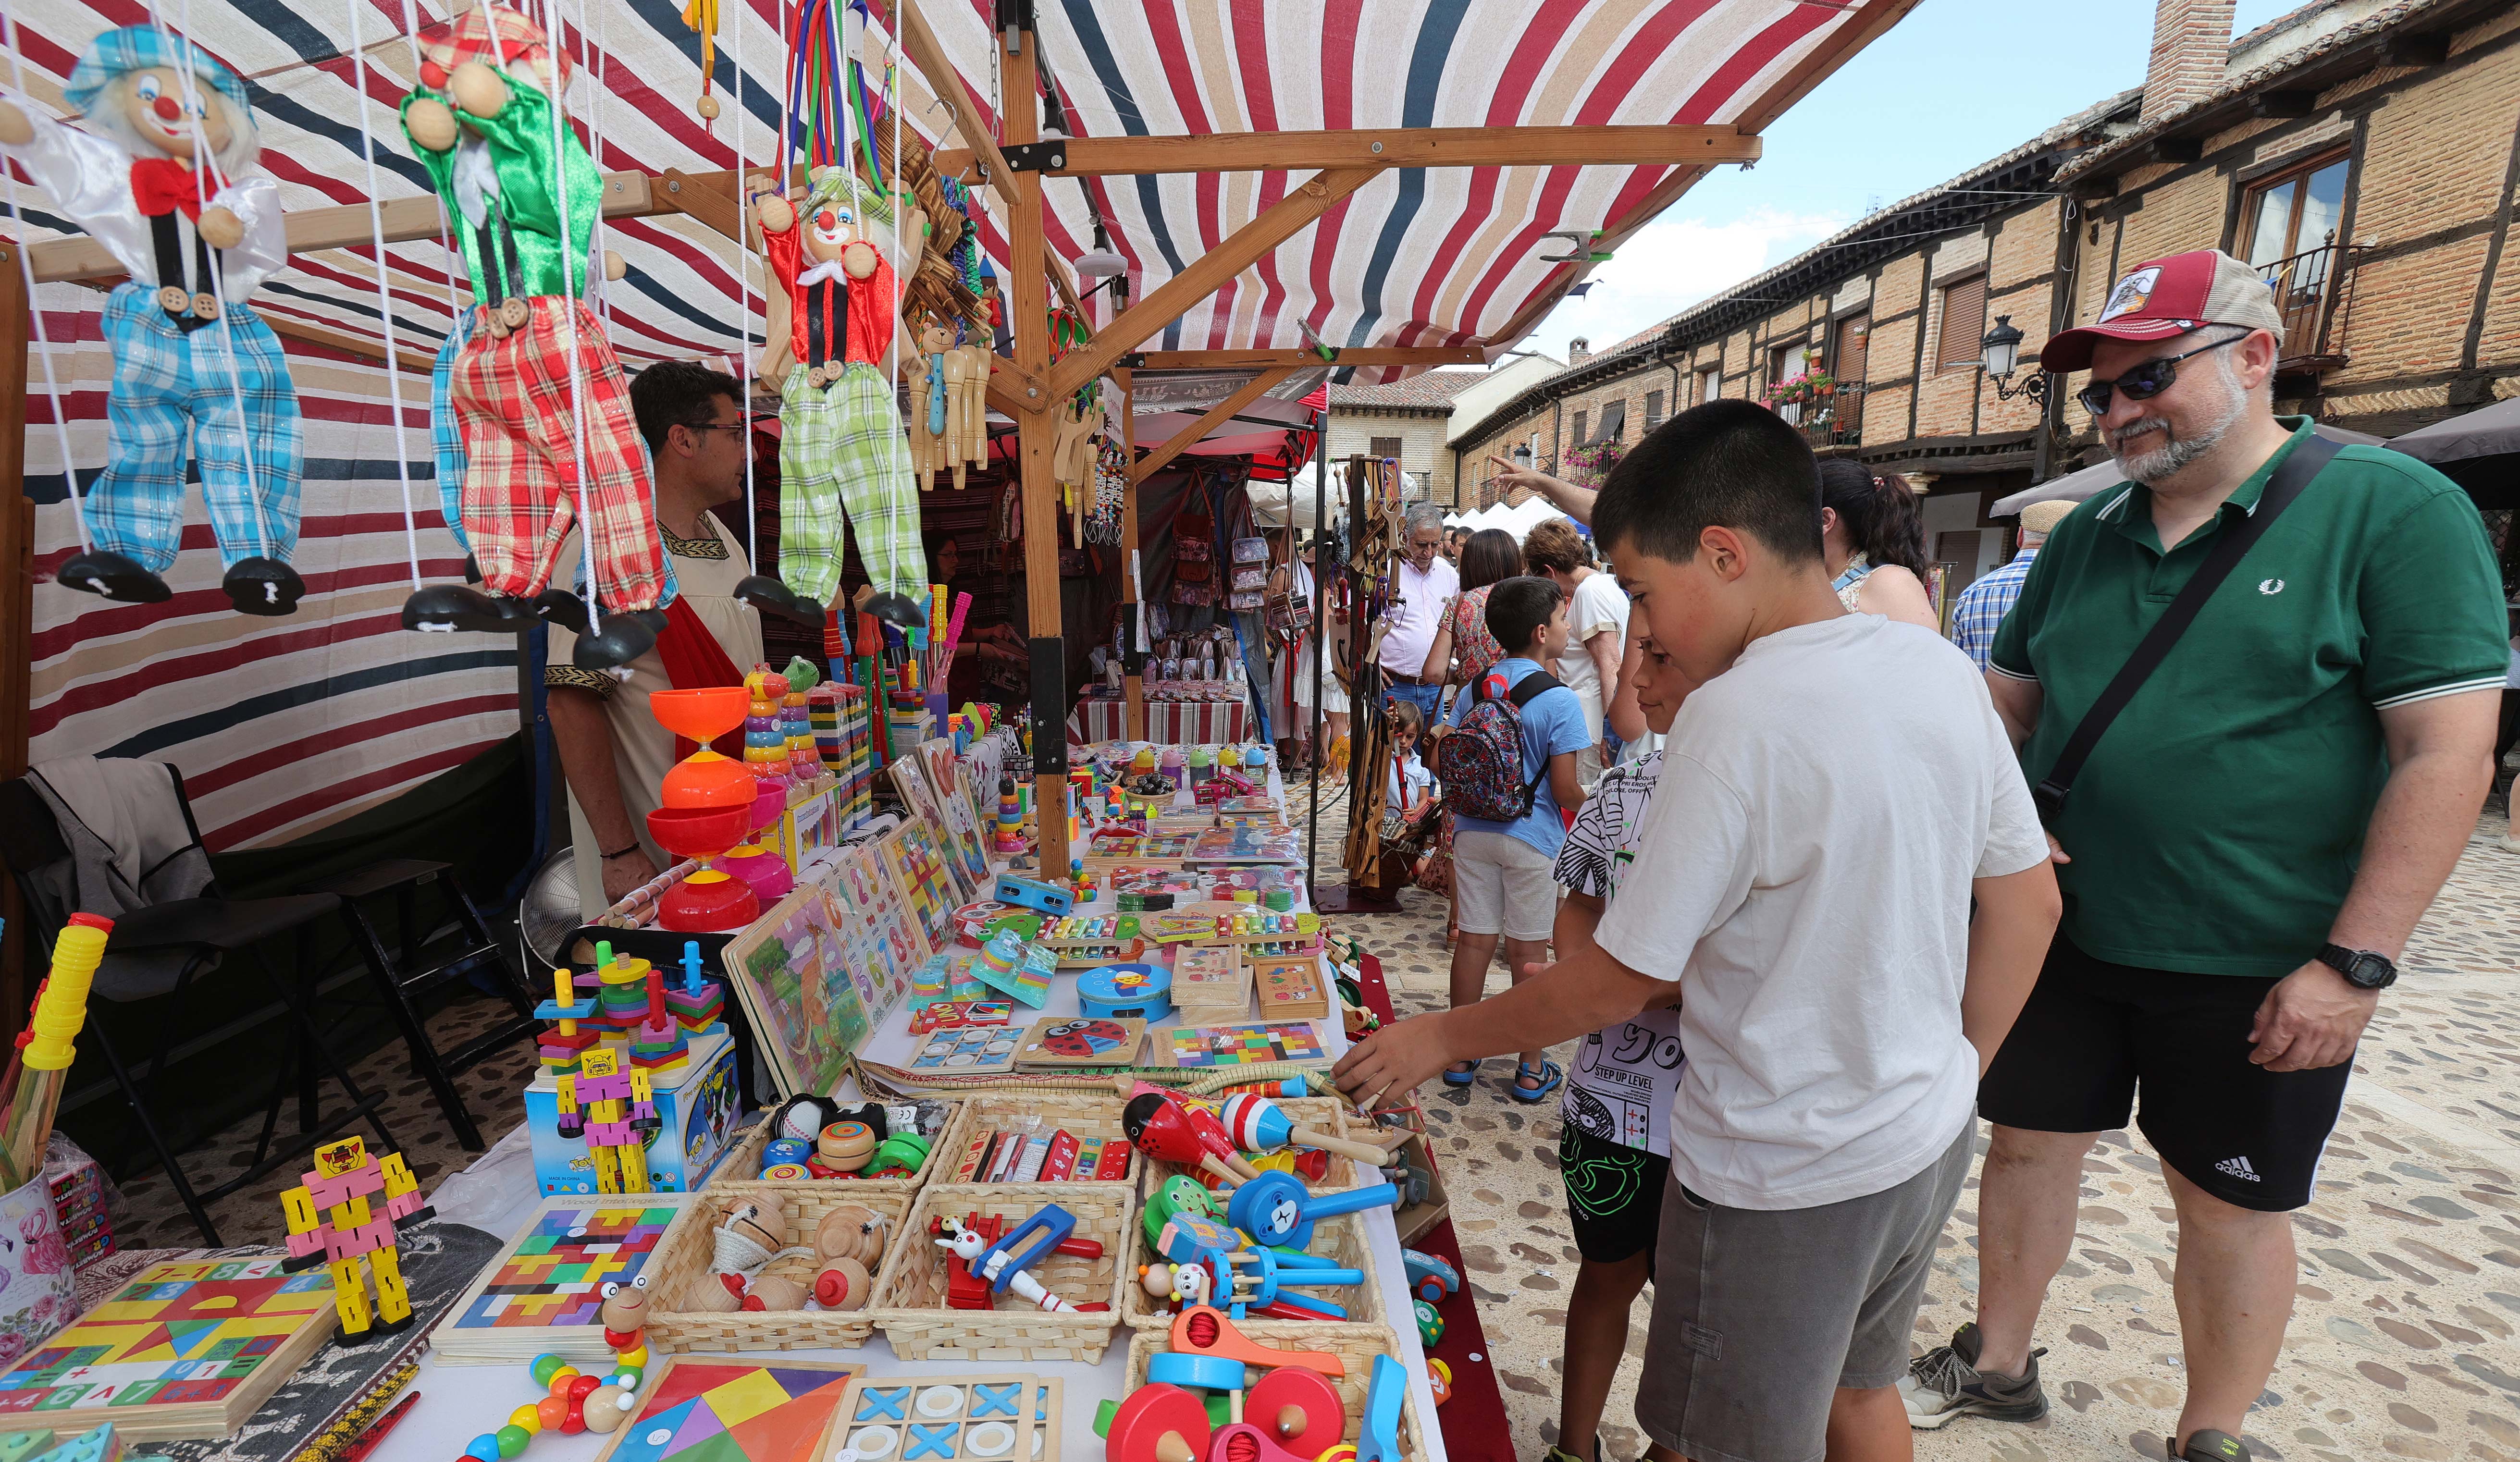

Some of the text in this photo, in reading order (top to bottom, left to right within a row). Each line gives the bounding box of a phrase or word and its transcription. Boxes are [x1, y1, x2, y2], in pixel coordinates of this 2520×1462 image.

[933, 1004, 961, 1022] UNO
[1594, 1066, 1654, 1091] STEP UP LEVEL
[1587, 1083, 1612, 1094] INTERNATIONAL
[1612, 1092, 1633, 1100] OUTERWEAR
[1630, 1089, 1652, 1097] WORLDWIDE
[689, 1134, 705, 1158] TOY
[569, 1156, 593, 1168] TOY
[688, 1163, 710, 1192] Wooden
[2215, 1162, 2261, 1182] adidas
